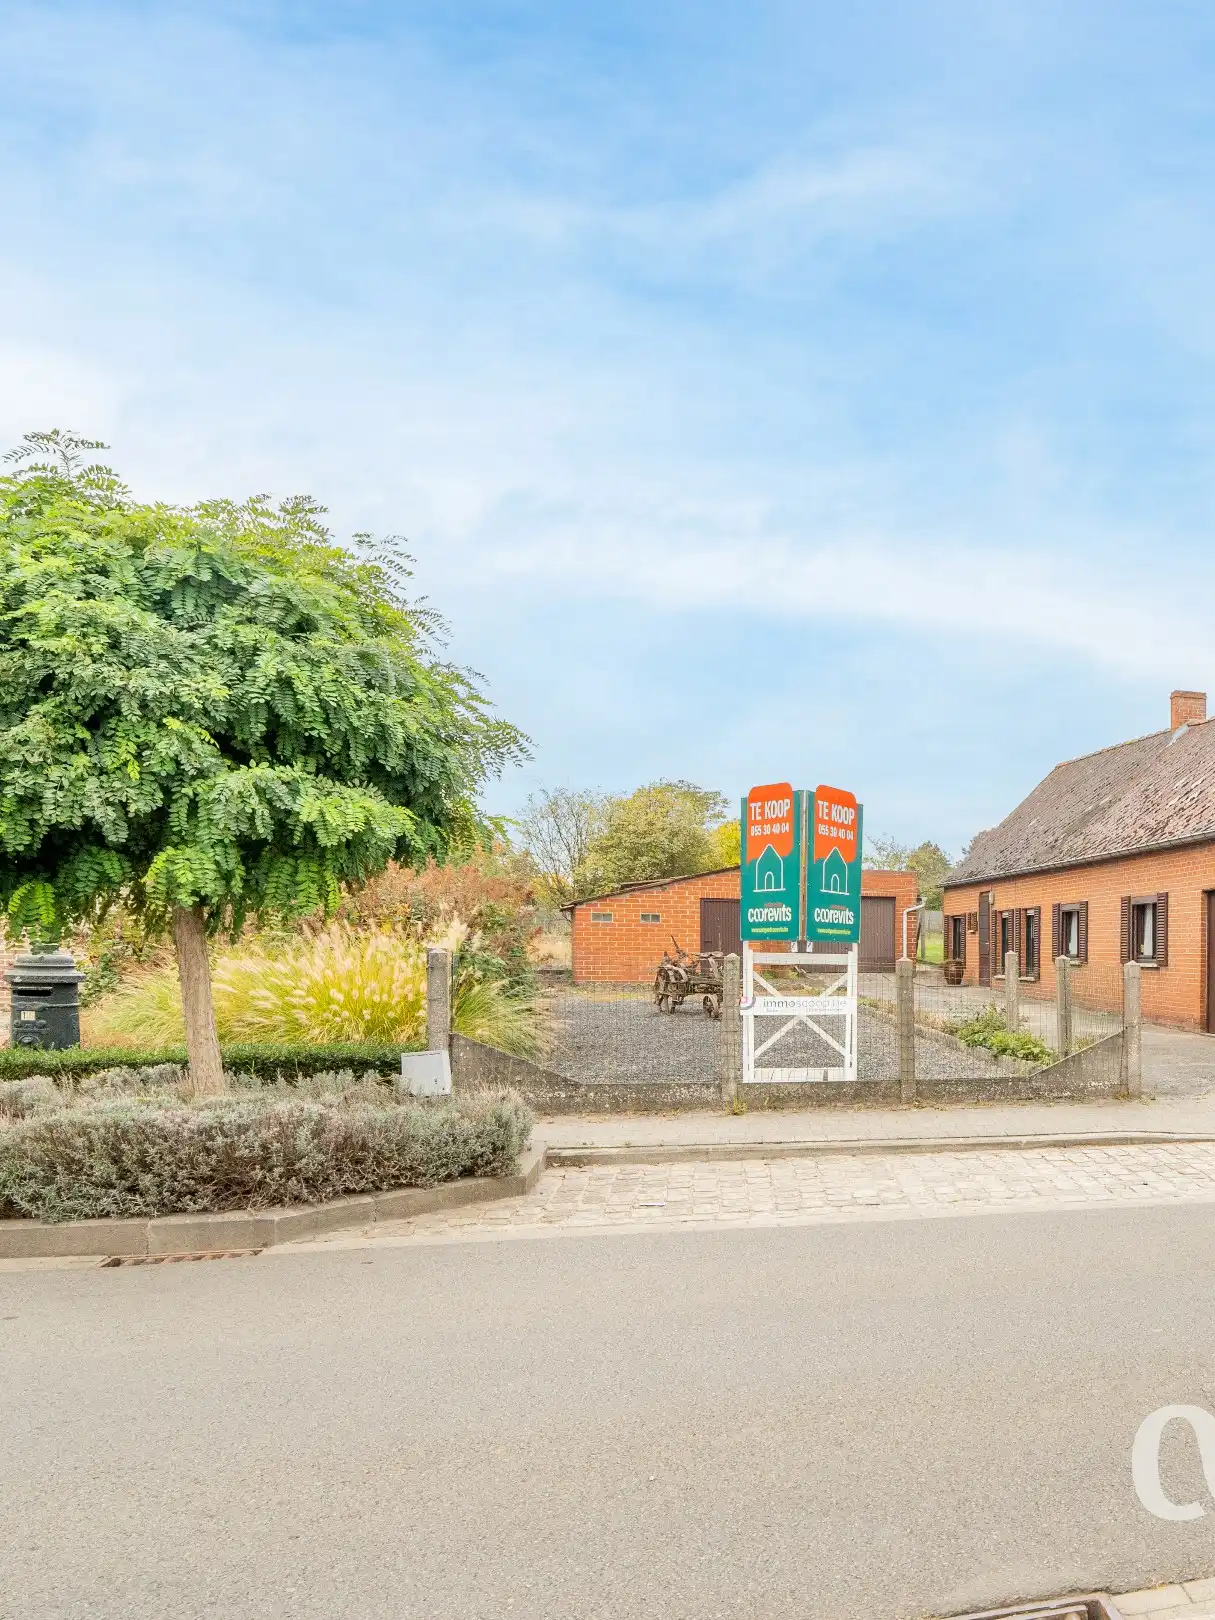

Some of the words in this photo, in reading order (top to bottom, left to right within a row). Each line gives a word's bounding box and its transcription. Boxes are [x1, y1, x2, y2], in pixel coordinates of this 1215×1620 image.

[750, 803, 761, 820] TE
[764, 799, 790, 820] KOOP
[818, 801, 829, 820] TE
[832, 804, 855, 825] KOOP
[751, 825, 762, 836] 055
[763, 824, 770, 835] 30
[772, 823, 780, 834] 40
[781, 822, 789, 833] 04
[818, 824, 829, 836] 055
[830, 826, 838, 838] 30
[838, 829, 846, 840] 40
[846, 830, 854, 841] 04
[748, 905, 792, 922] coorevits
[815, 908, 854, 925] coorevits
